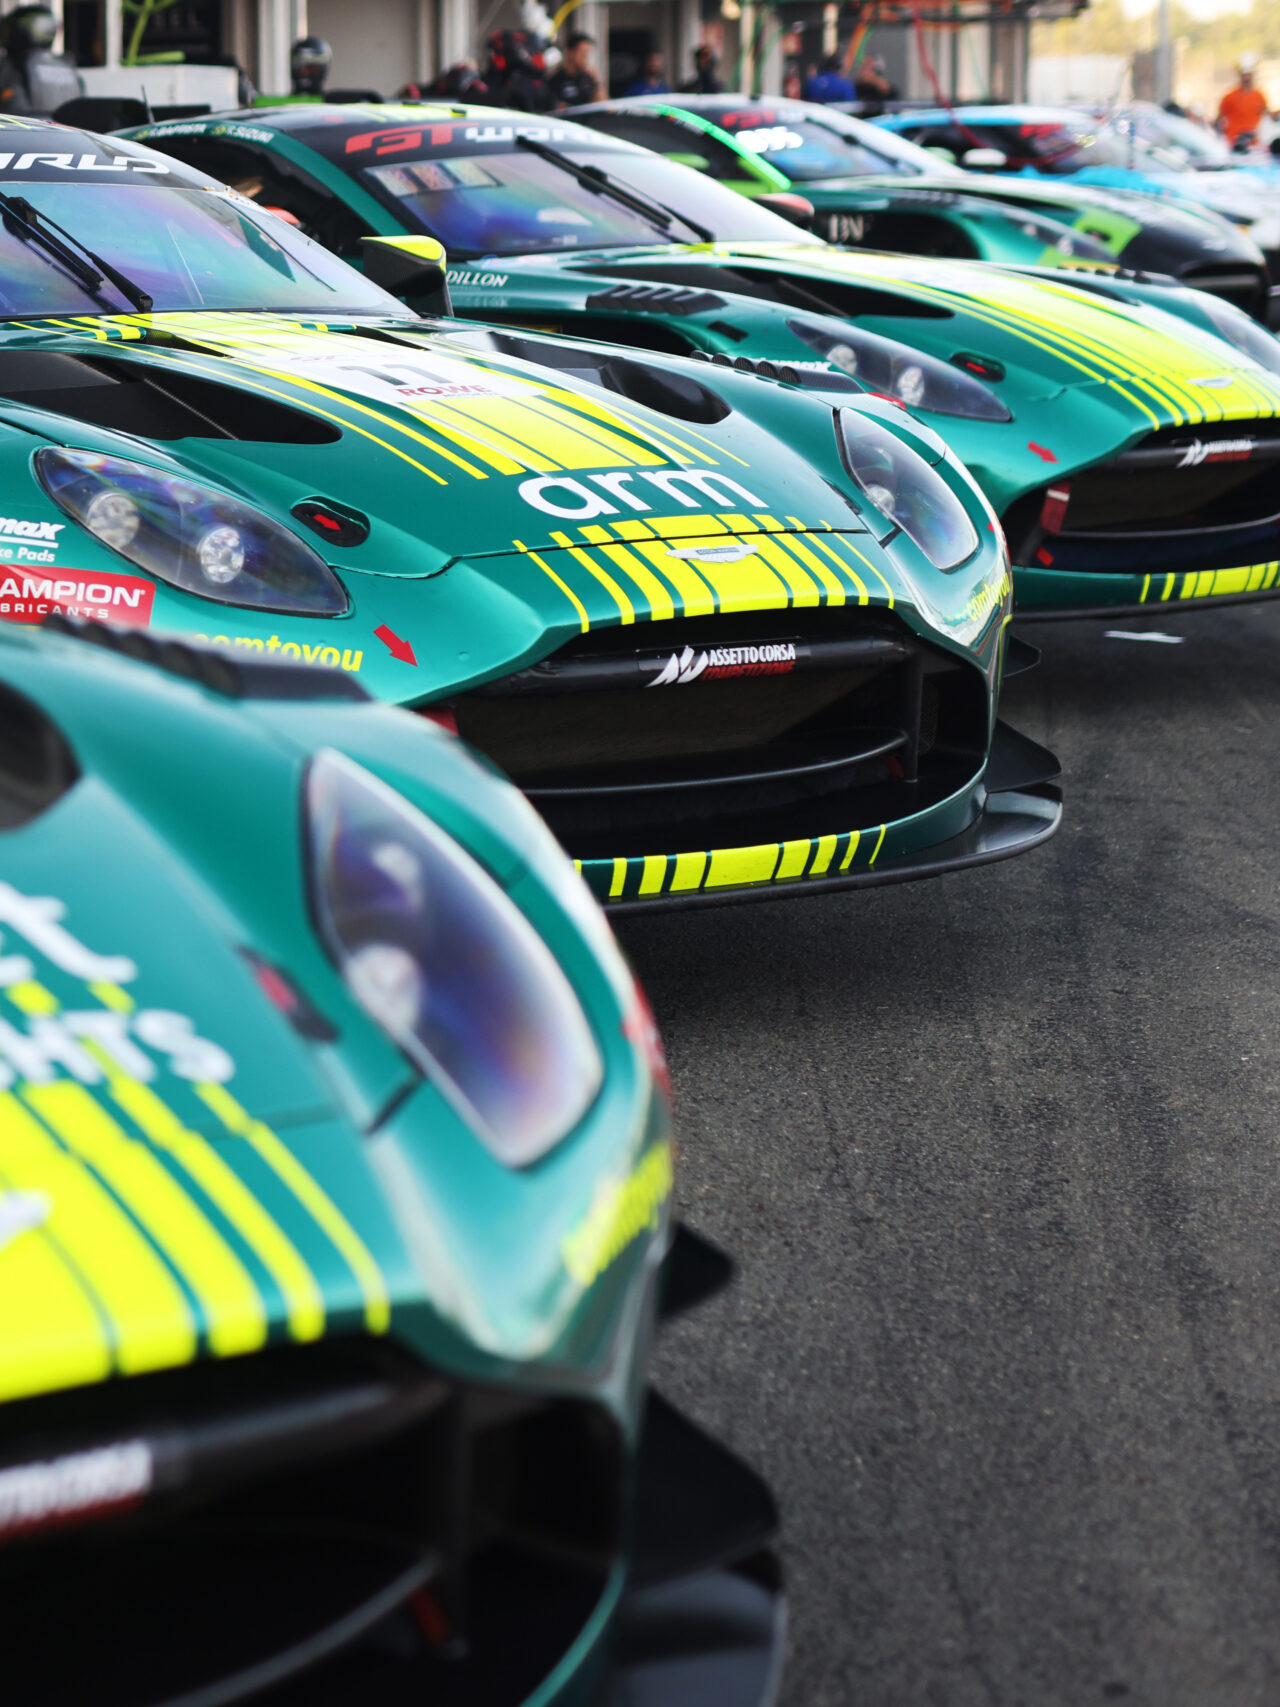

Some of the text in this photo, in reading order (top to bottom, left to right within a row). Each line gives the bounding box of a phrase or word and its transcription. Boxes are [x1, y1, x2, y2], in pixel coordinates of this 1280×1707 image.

[344, 122, 480, 156] GT
[336, 363, 454, 386] 11
[394, 384, 494, 397] ROWE
[517, 469, 770, 520] arm
[17, 546, 56, 563] Pads
[709, 643, 796, 666] ASSETTO CORSA
